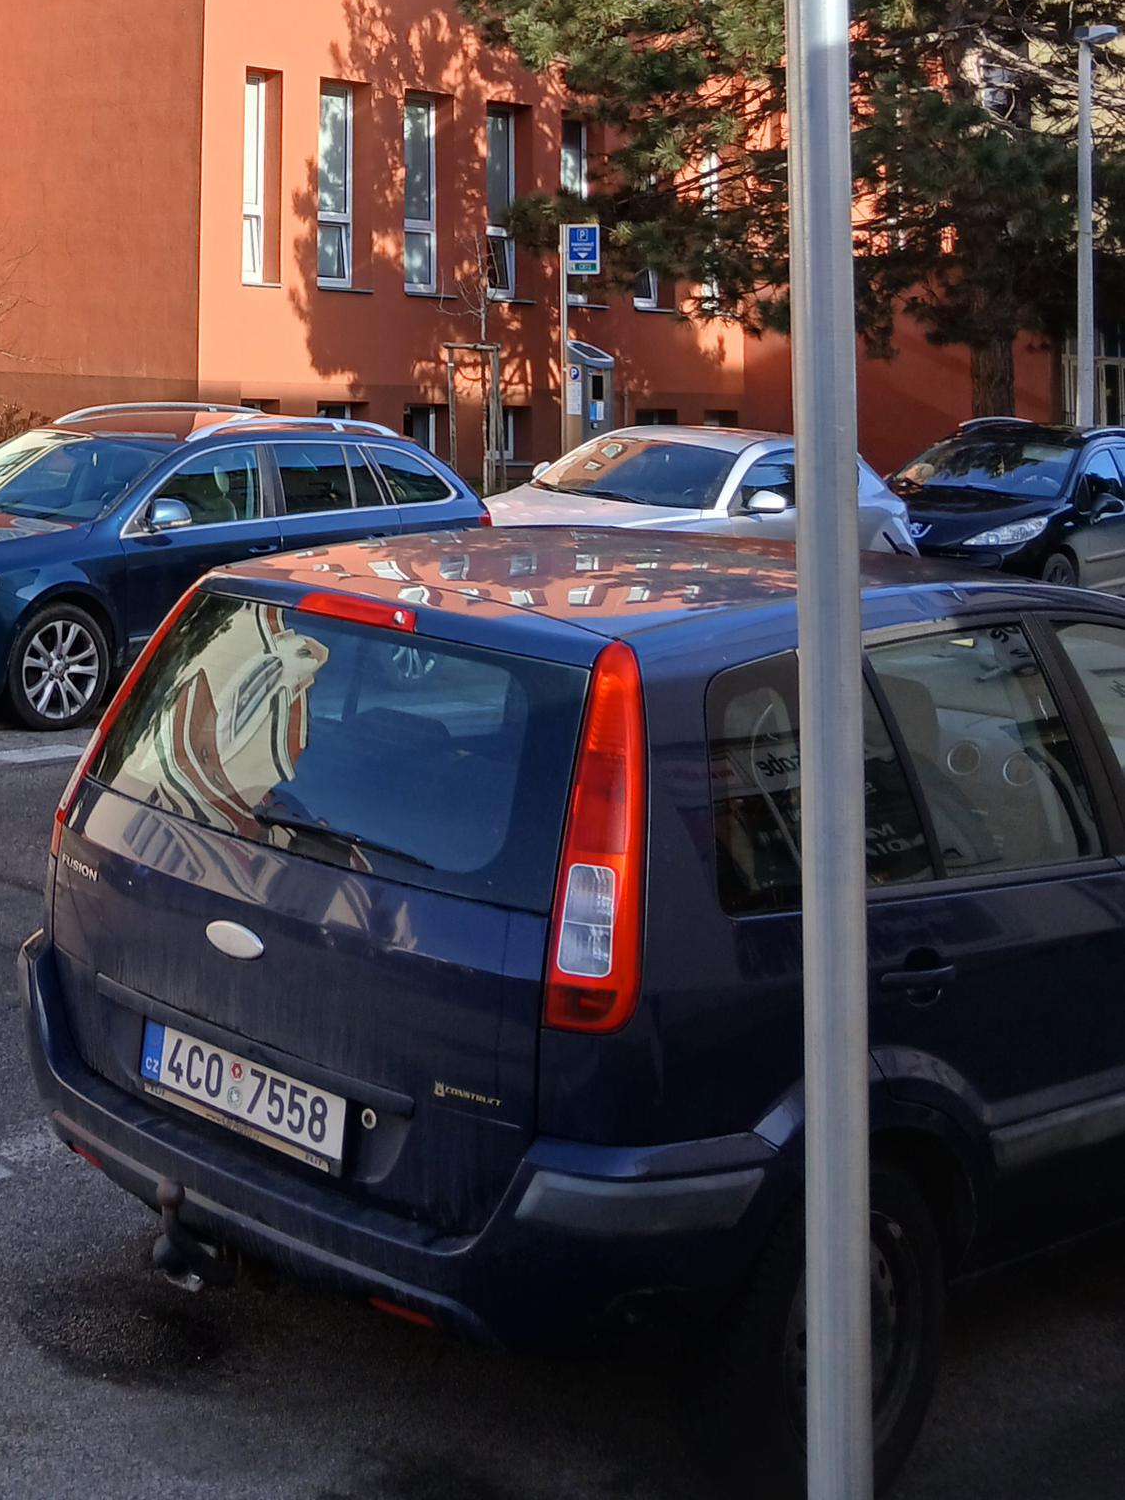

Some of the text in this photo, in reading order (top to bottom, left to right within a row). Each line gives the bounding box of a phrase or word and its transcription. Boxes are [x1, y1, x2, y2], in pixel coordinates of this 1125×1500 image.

[62, 853, 98, 882] FUSION
[145, 1056, 159, 1074] CZ
[246, 1068, 328, 1143] 7558
